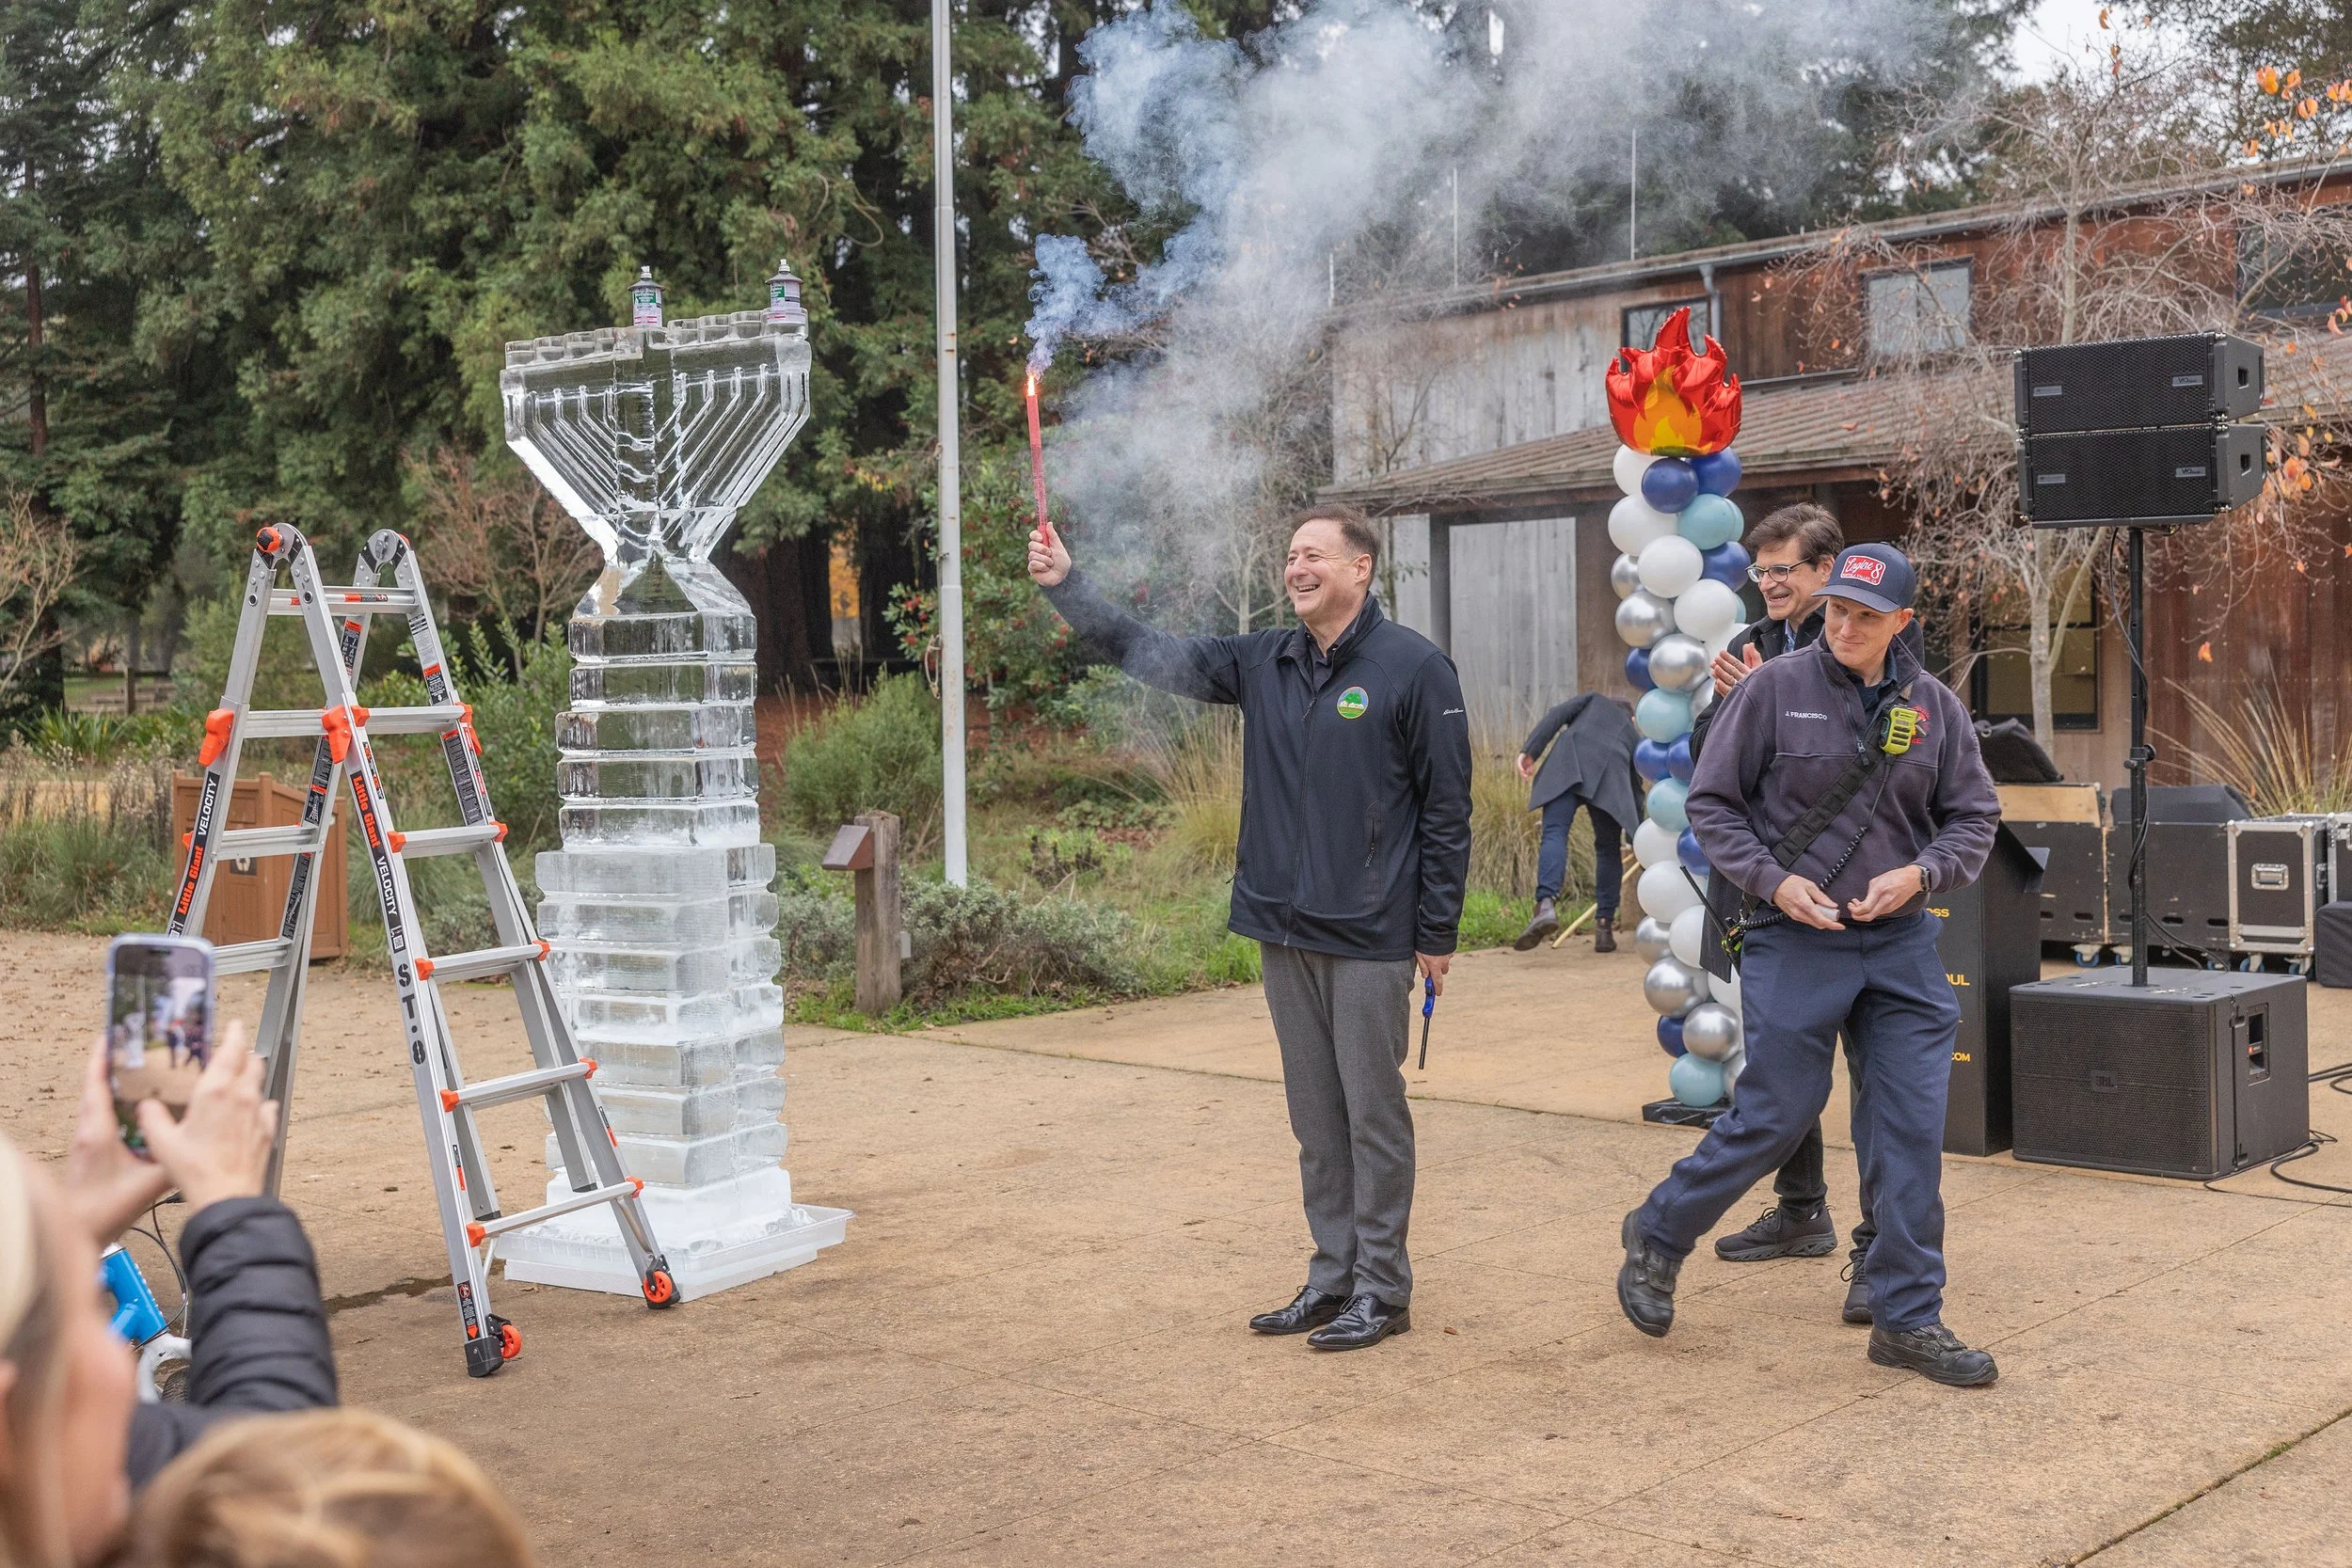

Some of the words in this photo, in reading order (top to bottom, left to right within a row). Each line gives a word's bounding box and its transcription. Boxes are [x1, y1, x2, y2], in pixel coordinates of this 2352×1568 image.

[1846, 558, 1873, 573] Engine
[1870, 563, 1883, 579] 8
[1790, 711, 1828, 721] FRANCISCO
[177, 880, 196, 915] Little
[188, 845, 204, 879] Giant
[198, 777, 217, 836] VELOCITY
[352, 774, 369, 812] Little
[362, 812, 382, 849] Giant
[375, 855, 398, 916] VELOCITY
